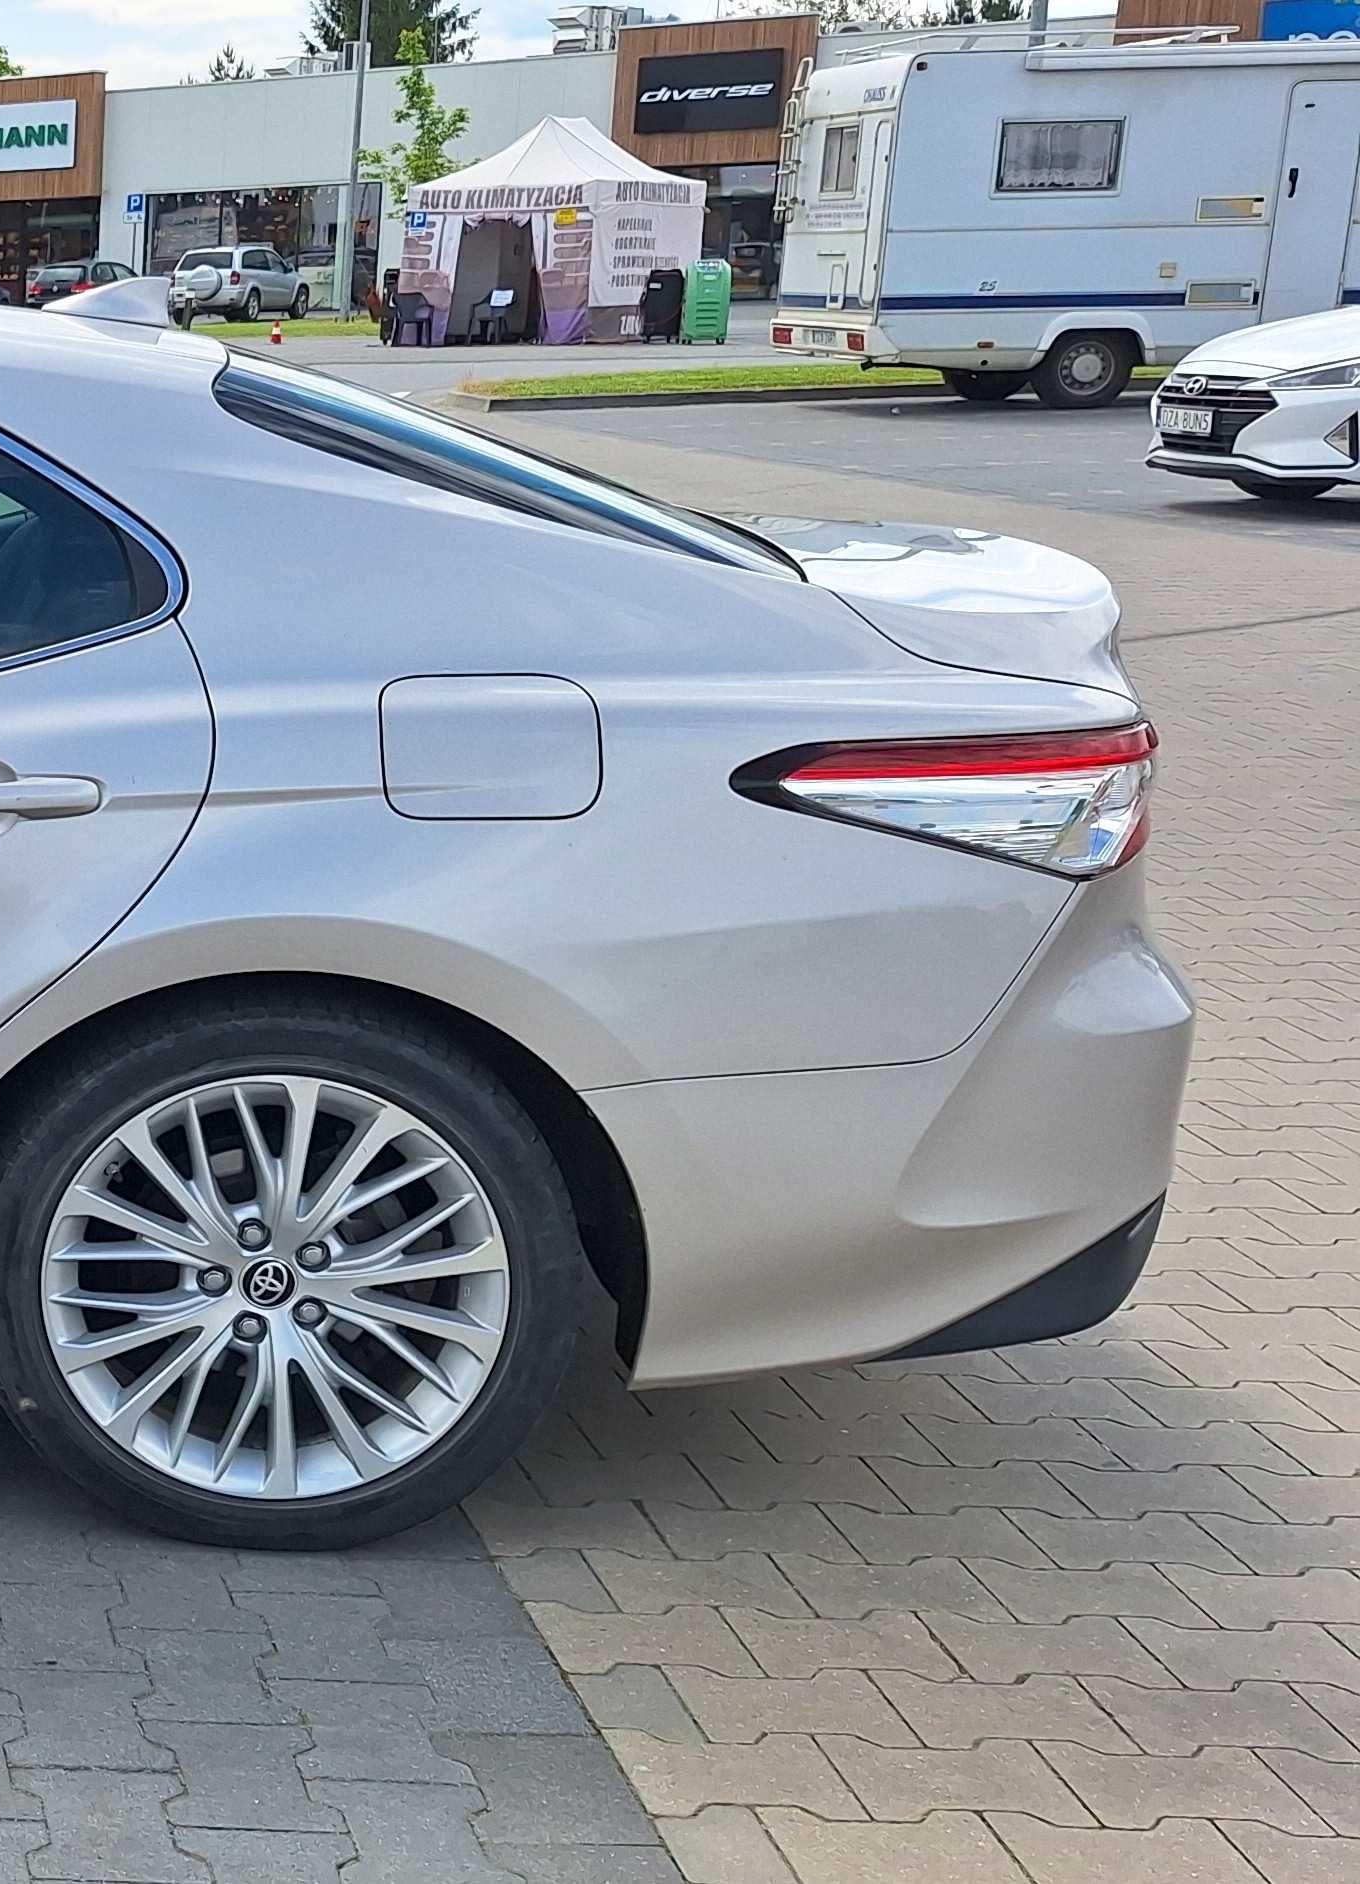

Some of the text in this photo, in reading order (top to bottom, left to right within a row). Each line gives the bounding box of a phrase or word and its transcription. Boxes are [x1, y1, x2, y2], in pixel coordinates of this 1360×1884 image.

[639, 82, 775, 103] diverse
[419, 185, 583, 210] AUTO KLIMATYZACJA
[616, 181, 640, 202] AUTO
[130, 196, 141, 210] P
[413, 213, 424, 227] P
